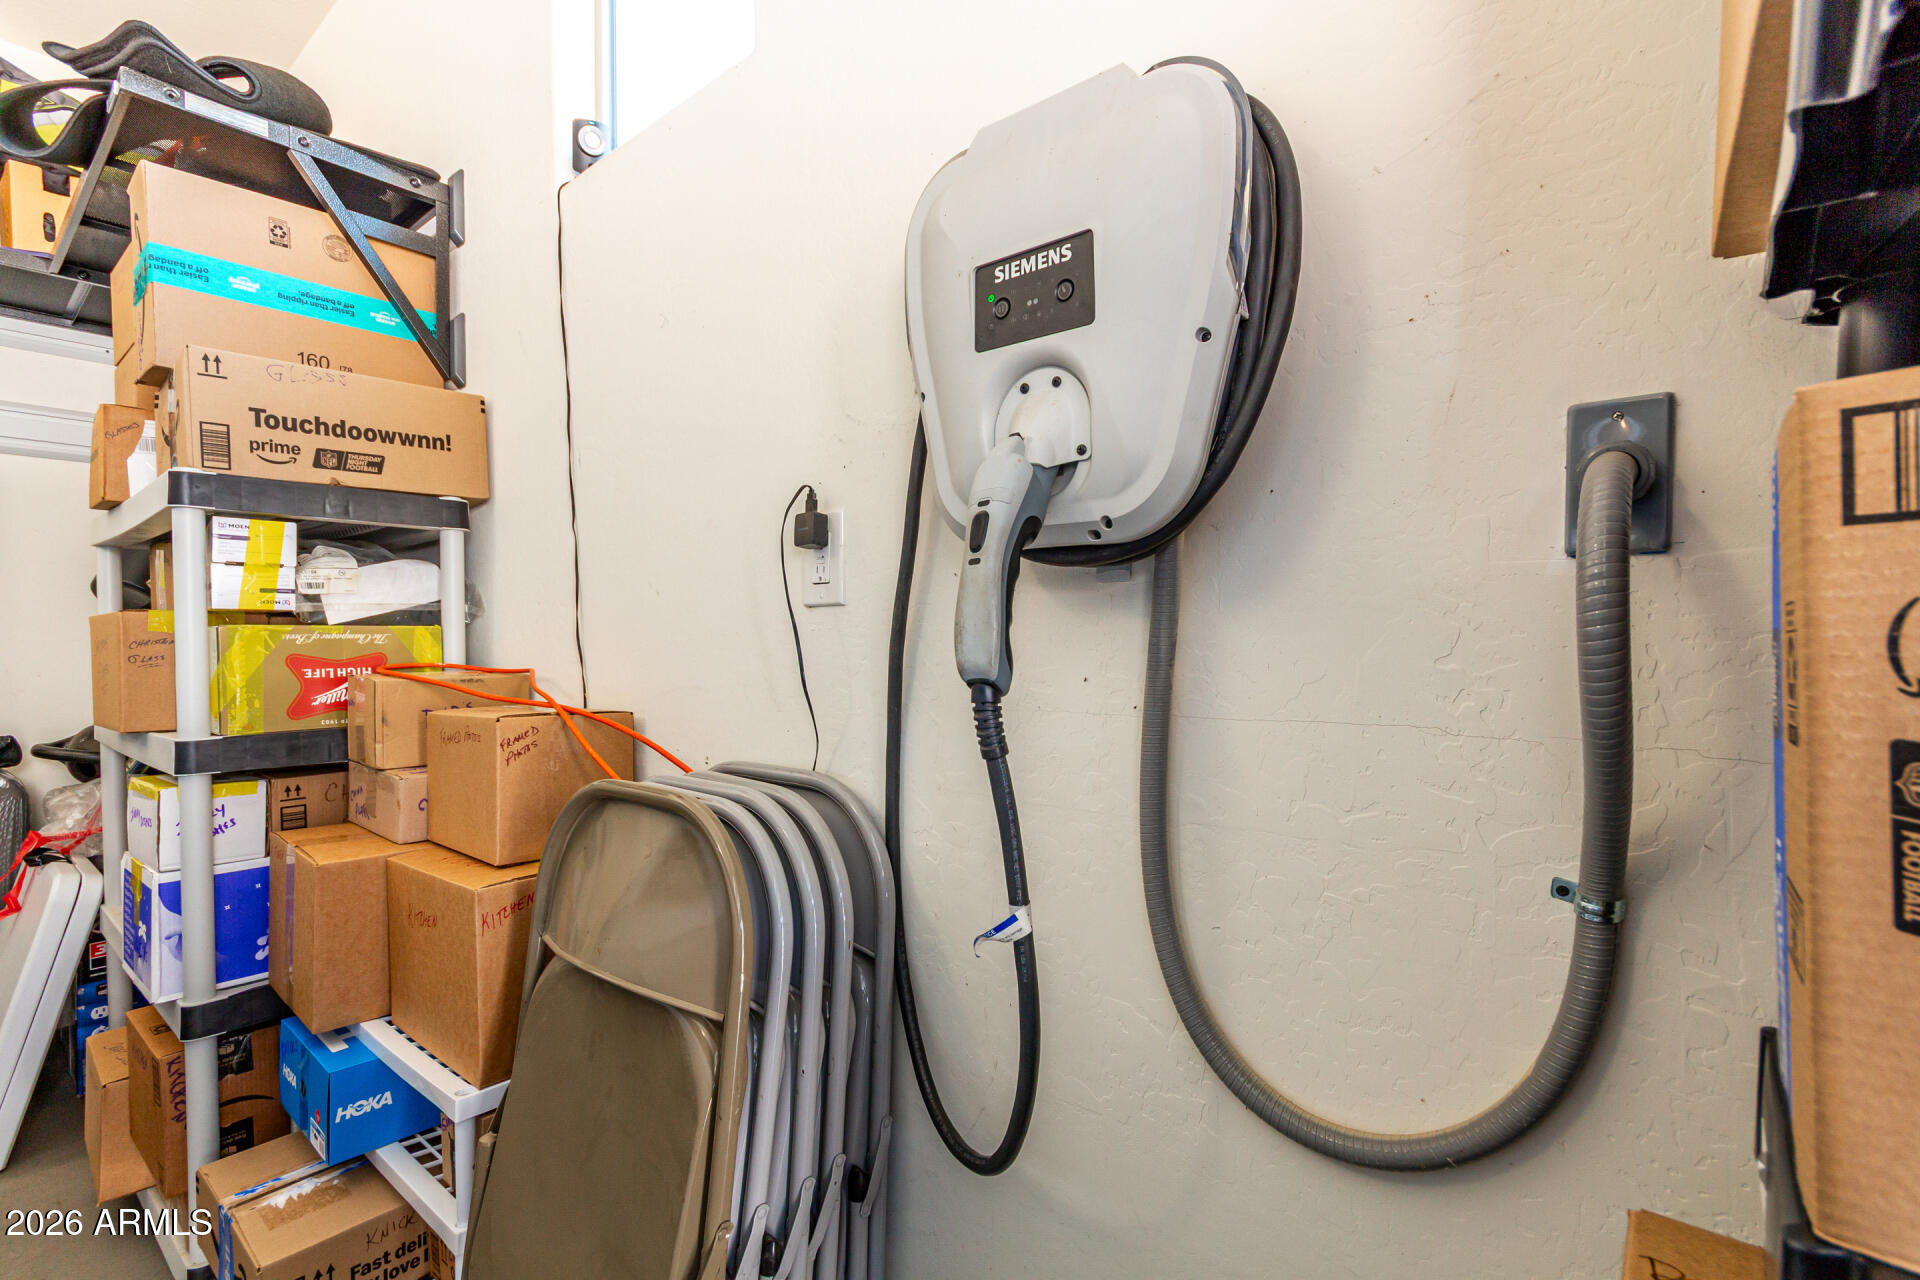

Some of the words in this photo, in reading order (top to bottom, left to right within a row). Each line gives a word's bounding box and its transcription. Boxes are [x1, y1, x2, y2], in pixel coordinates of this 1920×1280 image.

[148, 254, 186, 270] bandag
[994, 243, 1073, 284] SIEMENS
[153, 264, 177, 276] than
[179, 270, 209, 283] Easier
[195, 266, 209, 274] off
[277, 292, 309, 306] ripping
[309, 300, 328, 311] than
[342, 301, 355, 309] off
[330, 306, 355, 318] Easier
[297, 351, 330, 369] 160
[248, 406, 452, 452] Touchdoowwnn!
[249, 438, 301, 456] prime
[348, 453, 383, 463] THURSDAY
[346, 464, 379, 473] FOOTBALL
[309, 631, 320, 643] of
[320, 629, 372, 645] Champagne
[373, 632, 392, 644] The
[304, 667, 334, 678] LIFE
[337, 666, 372, 678] HIGH
[499, 726, 540, 751] FRAMED
[408, 903, 438, 929] KITCHEN
[481, 891, 535, 937] KITCHEN
[282, 1063, 297, 1090] HOKA
[334, 1090, 393, 1124] HOKA
[350, 1250, 391, 1280] Fast
[383, 1255, 421, 1280] love
